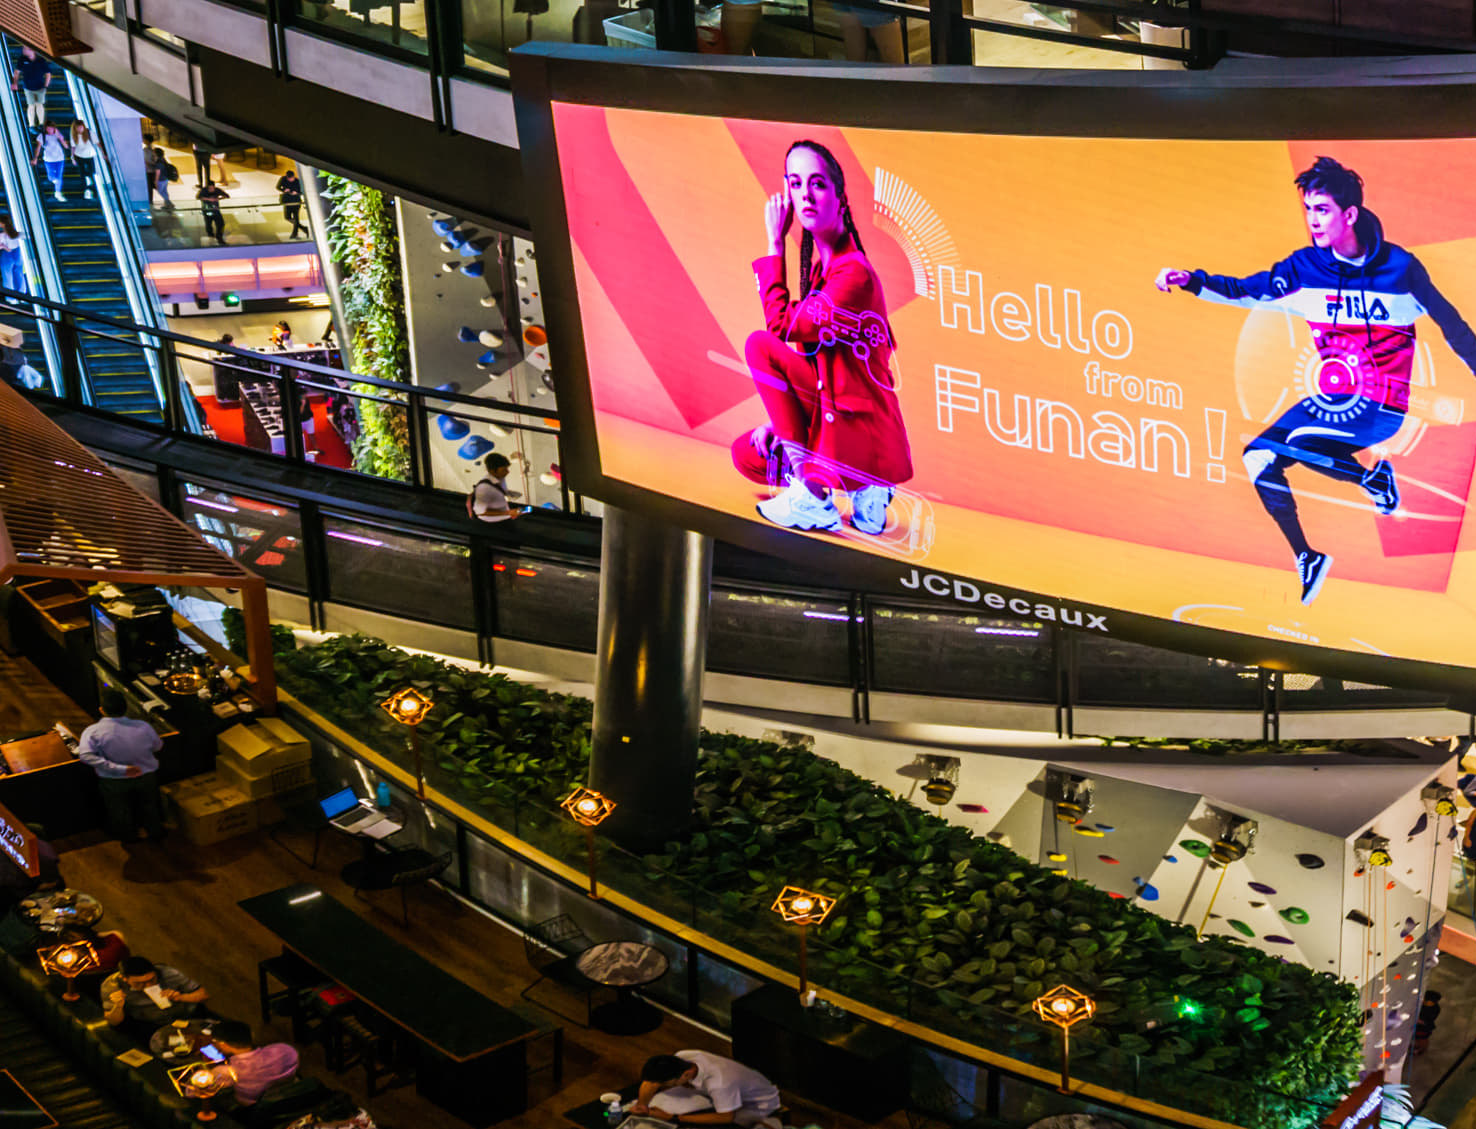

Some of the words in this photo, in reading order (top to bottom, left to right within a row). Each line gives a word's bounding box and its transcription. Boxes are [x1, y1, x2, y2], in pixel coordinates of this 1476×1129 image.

[937, 264, 1133, 359] Hello
[1325, 295, 1390, 320] FILA
[1084, 361, 1182, 409] from
[900, 569, 1109, 632] JCDecaux
